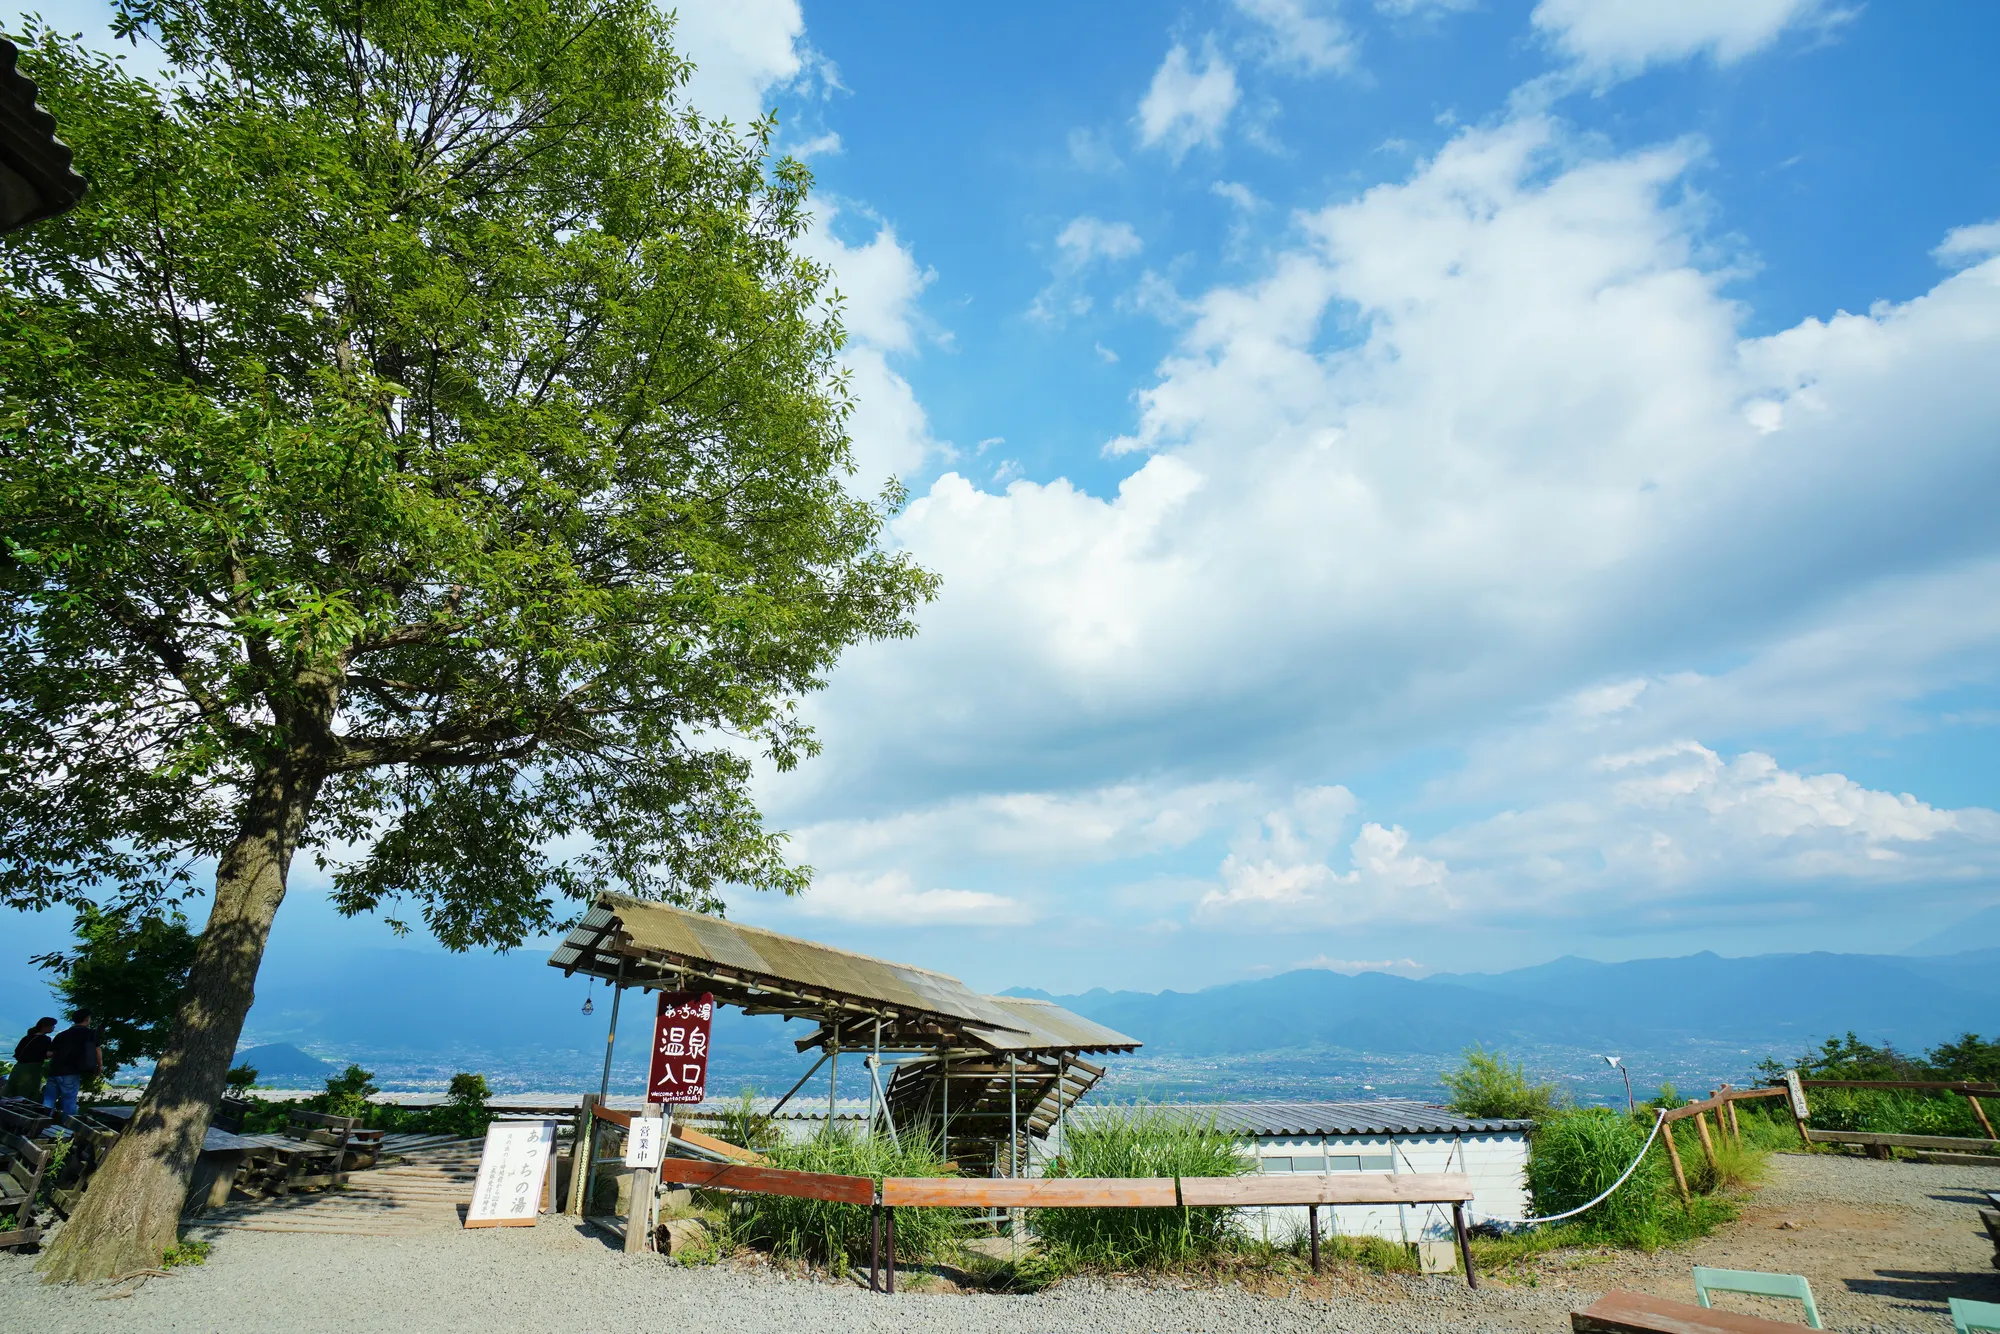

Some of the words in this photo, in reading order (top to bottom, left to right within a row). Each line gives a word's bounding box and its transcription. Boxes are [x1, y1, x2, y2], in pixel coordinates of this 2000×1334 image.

[665, 1003, 711, 1021] あっちの湯
[659, 1026, 706, 1059] 温泉
[657, 1063, 701, 1086] 入口
[687, 1085, 703, 1096] SPA
[636, 1126, 650, 1162] 営業中
[510, 1129, 539, 1214] あっちの湯
